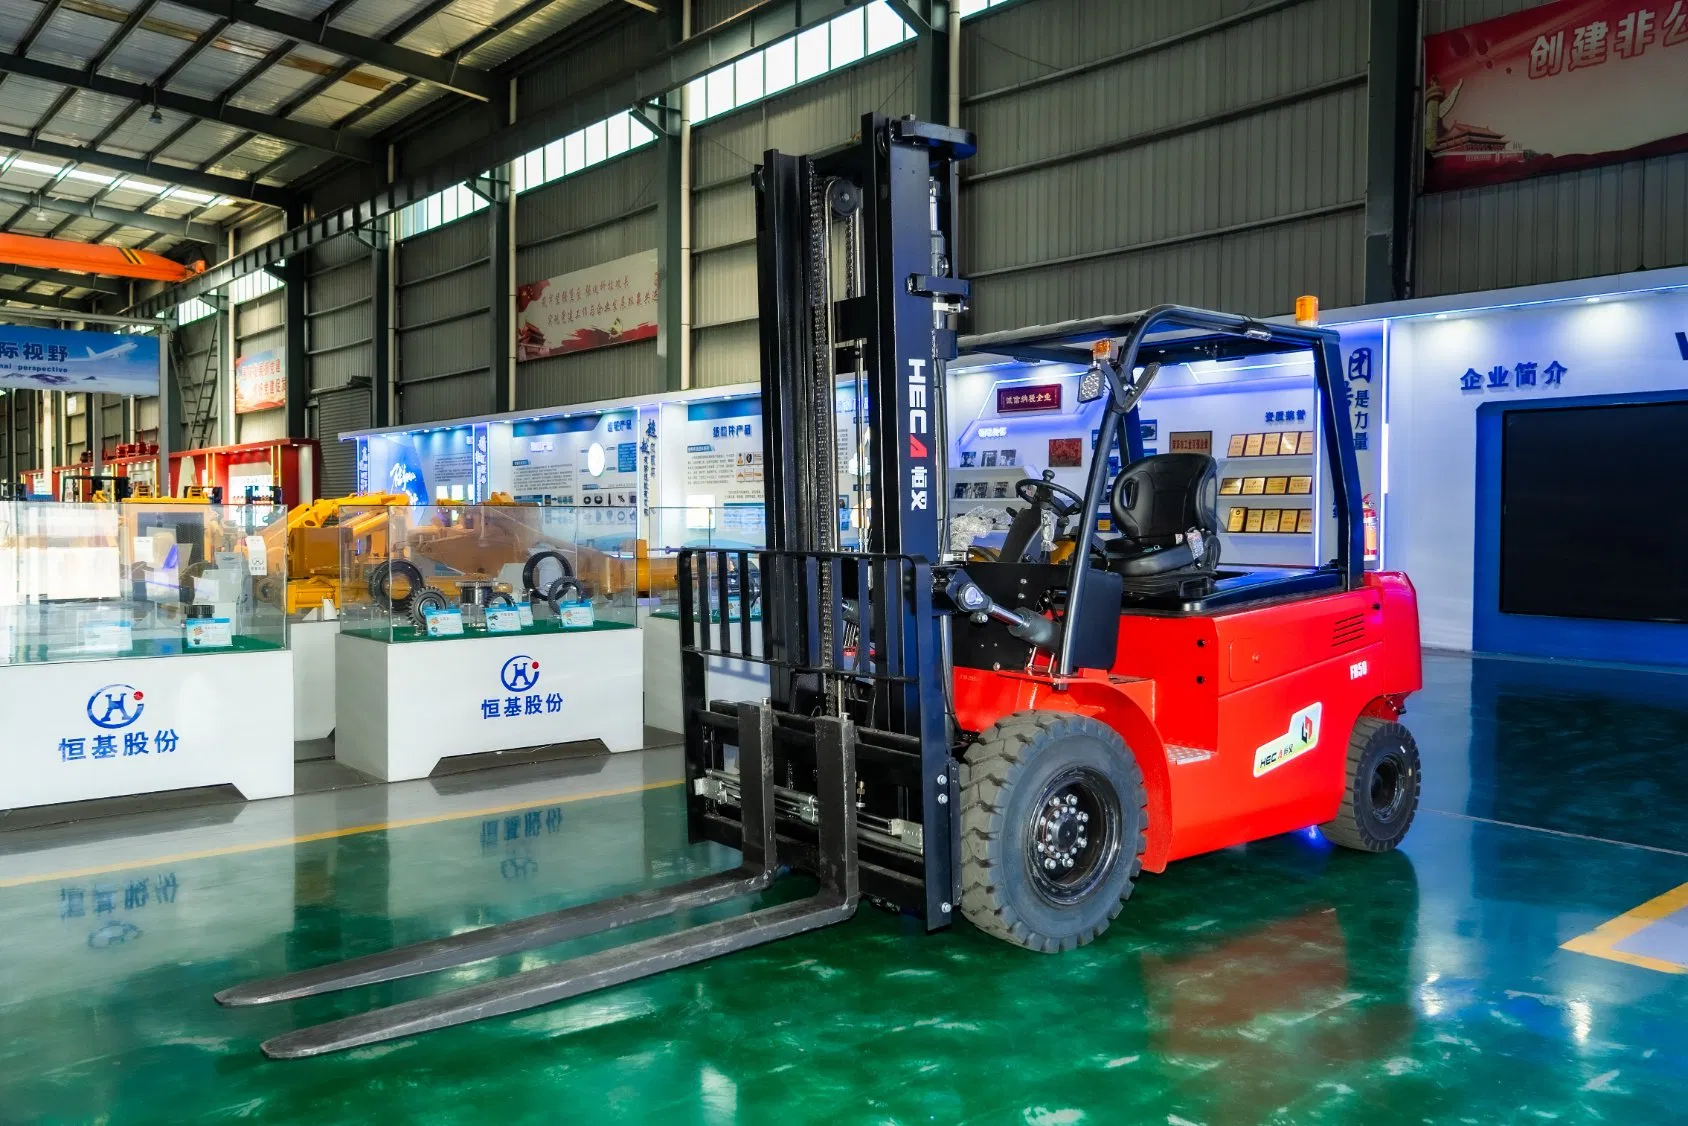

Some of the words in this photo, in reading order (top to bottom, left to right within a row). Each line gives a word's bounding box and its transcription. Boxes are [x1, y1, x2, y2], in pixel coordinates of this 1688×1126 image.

[17, 365, 68, 373] perspective
[1460, 360, 1568, 391] 企业简介
[908, 358, 928, 458] HECA
[481, 692, 563, 720] 恒基股份
[58, 728, 180, 763] 恒基股份
